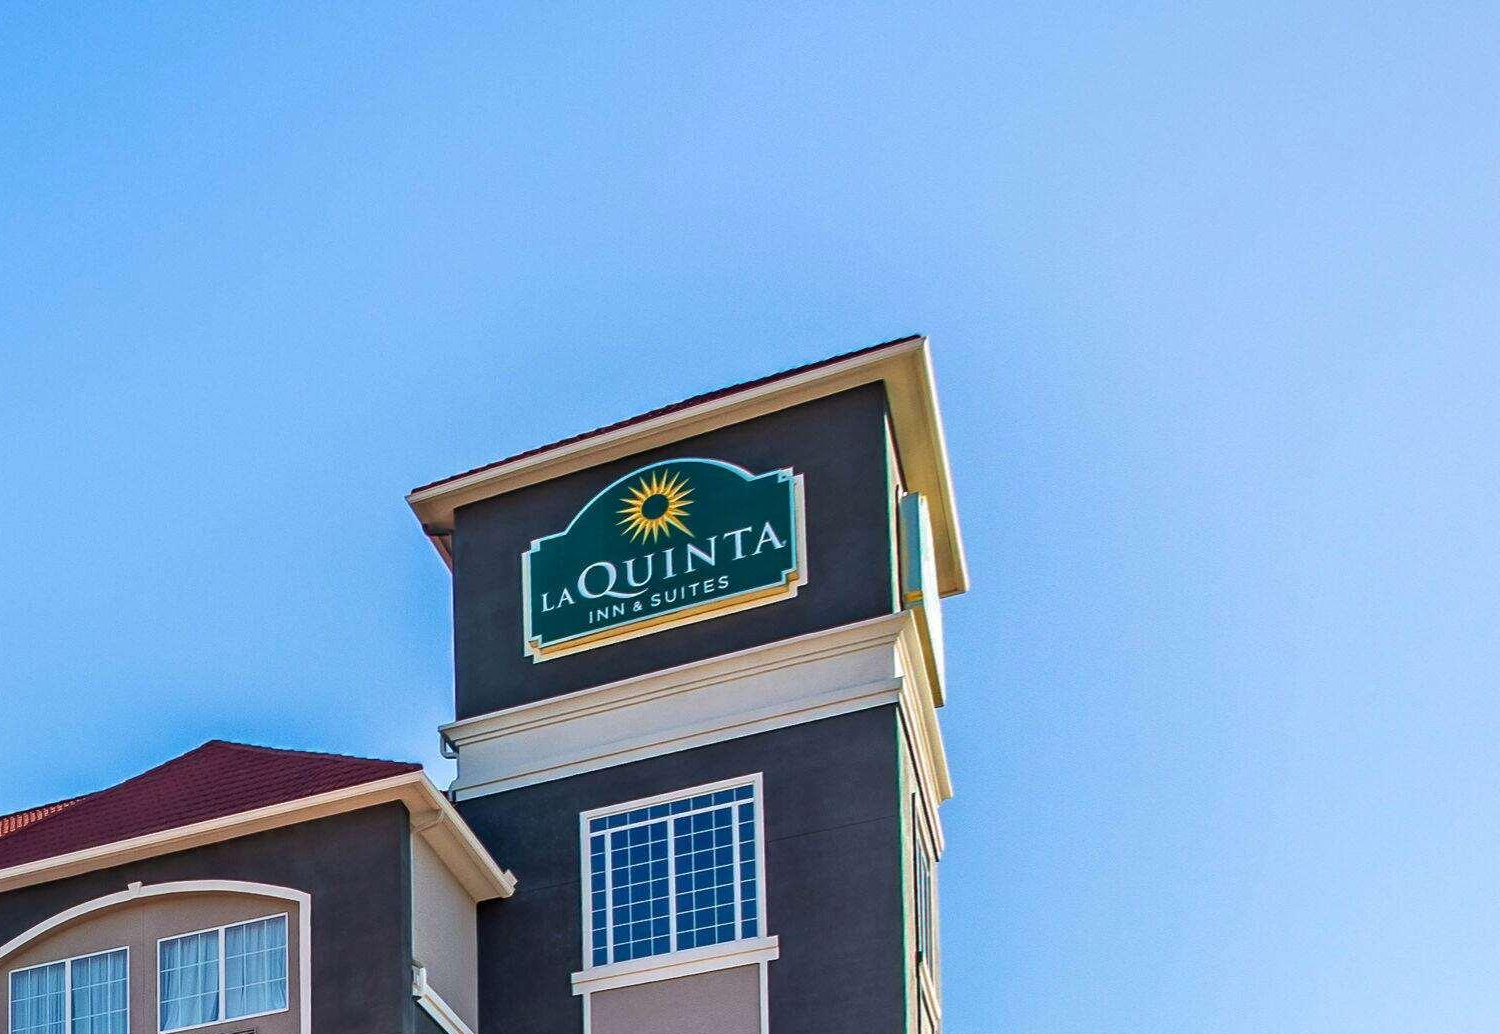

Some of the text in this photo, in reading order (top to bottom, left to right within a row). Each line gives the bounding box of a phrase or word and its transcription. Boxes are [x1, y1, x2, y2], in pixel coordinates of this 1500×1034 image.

[540, 521, 787, 613] LA QUINTA
[588, 575, 730, 624] INN & SUITES
